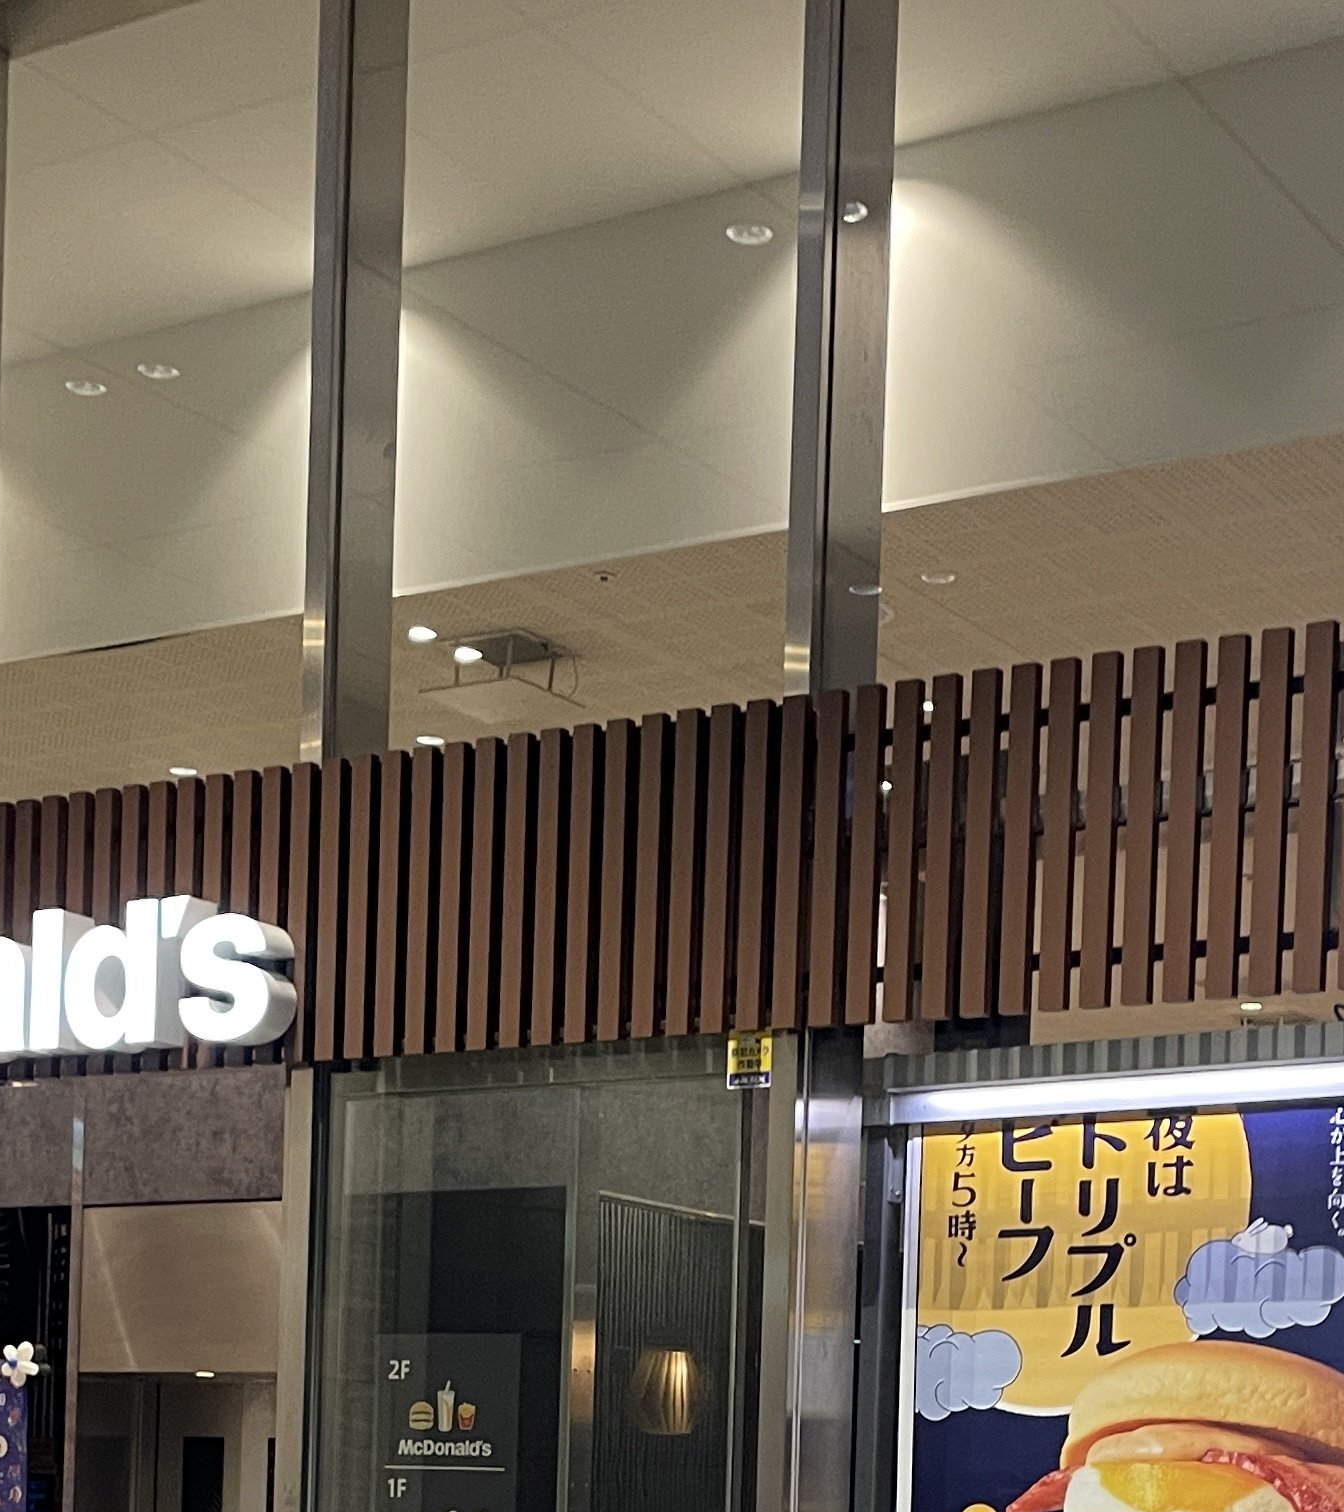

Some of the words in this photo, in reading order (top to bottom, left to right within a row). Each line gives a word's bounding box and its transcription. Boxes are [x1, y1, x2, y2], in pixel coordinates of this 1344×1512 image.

[1143, 1108, 1195, 1197] 夜は
[1060, 1113, 1137, 1358] トリプル
[388, 1360, 411, 1380] 2F
[398, 1438, 492, 1457] McDonald's
[387, 1478, 407, 1498] 1F
